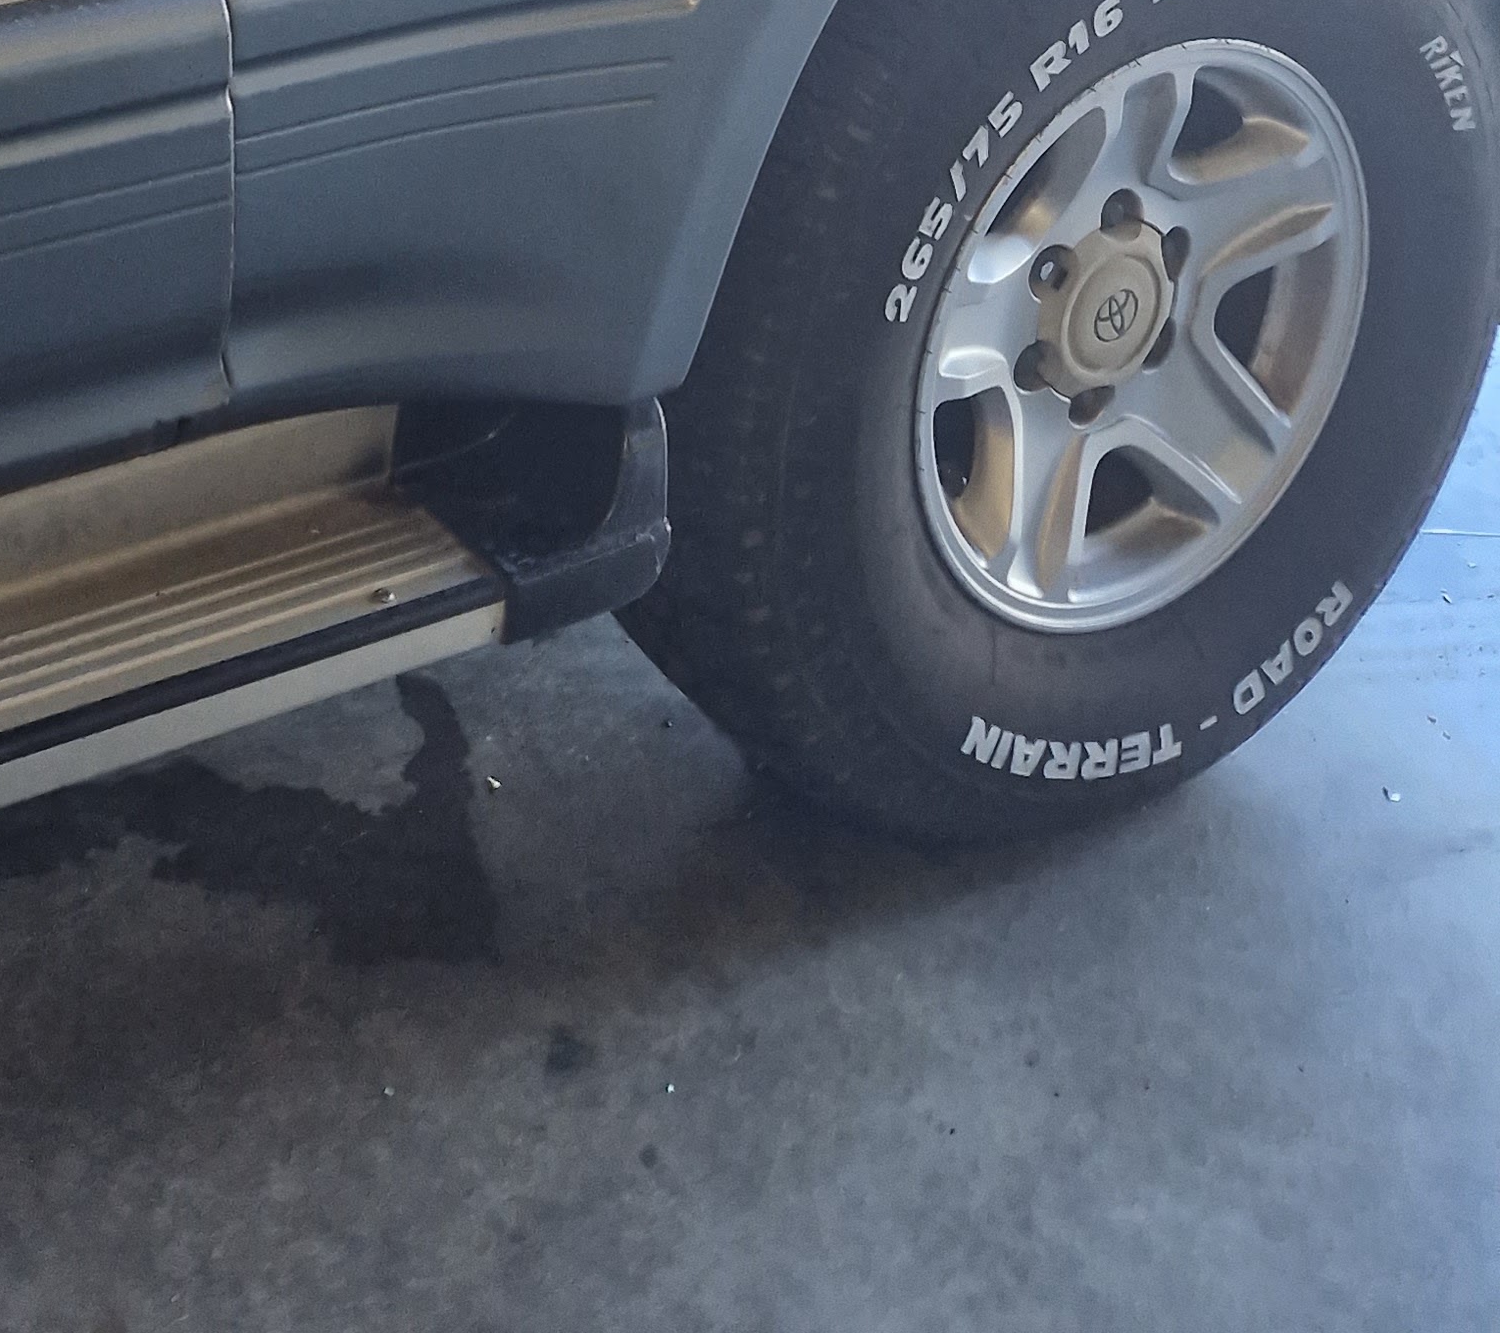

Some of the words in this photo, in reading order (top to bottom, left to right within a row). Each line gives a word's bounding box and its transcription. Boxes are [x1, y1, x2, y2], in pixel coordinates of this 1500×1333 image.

[1419, 35, 1476, 131] RIKEN
[884, 91, 1024, 323] 265/75
[1233, 581, 1353, 715] ROAD
[960, 715, 1182, 781] TERRAIN
